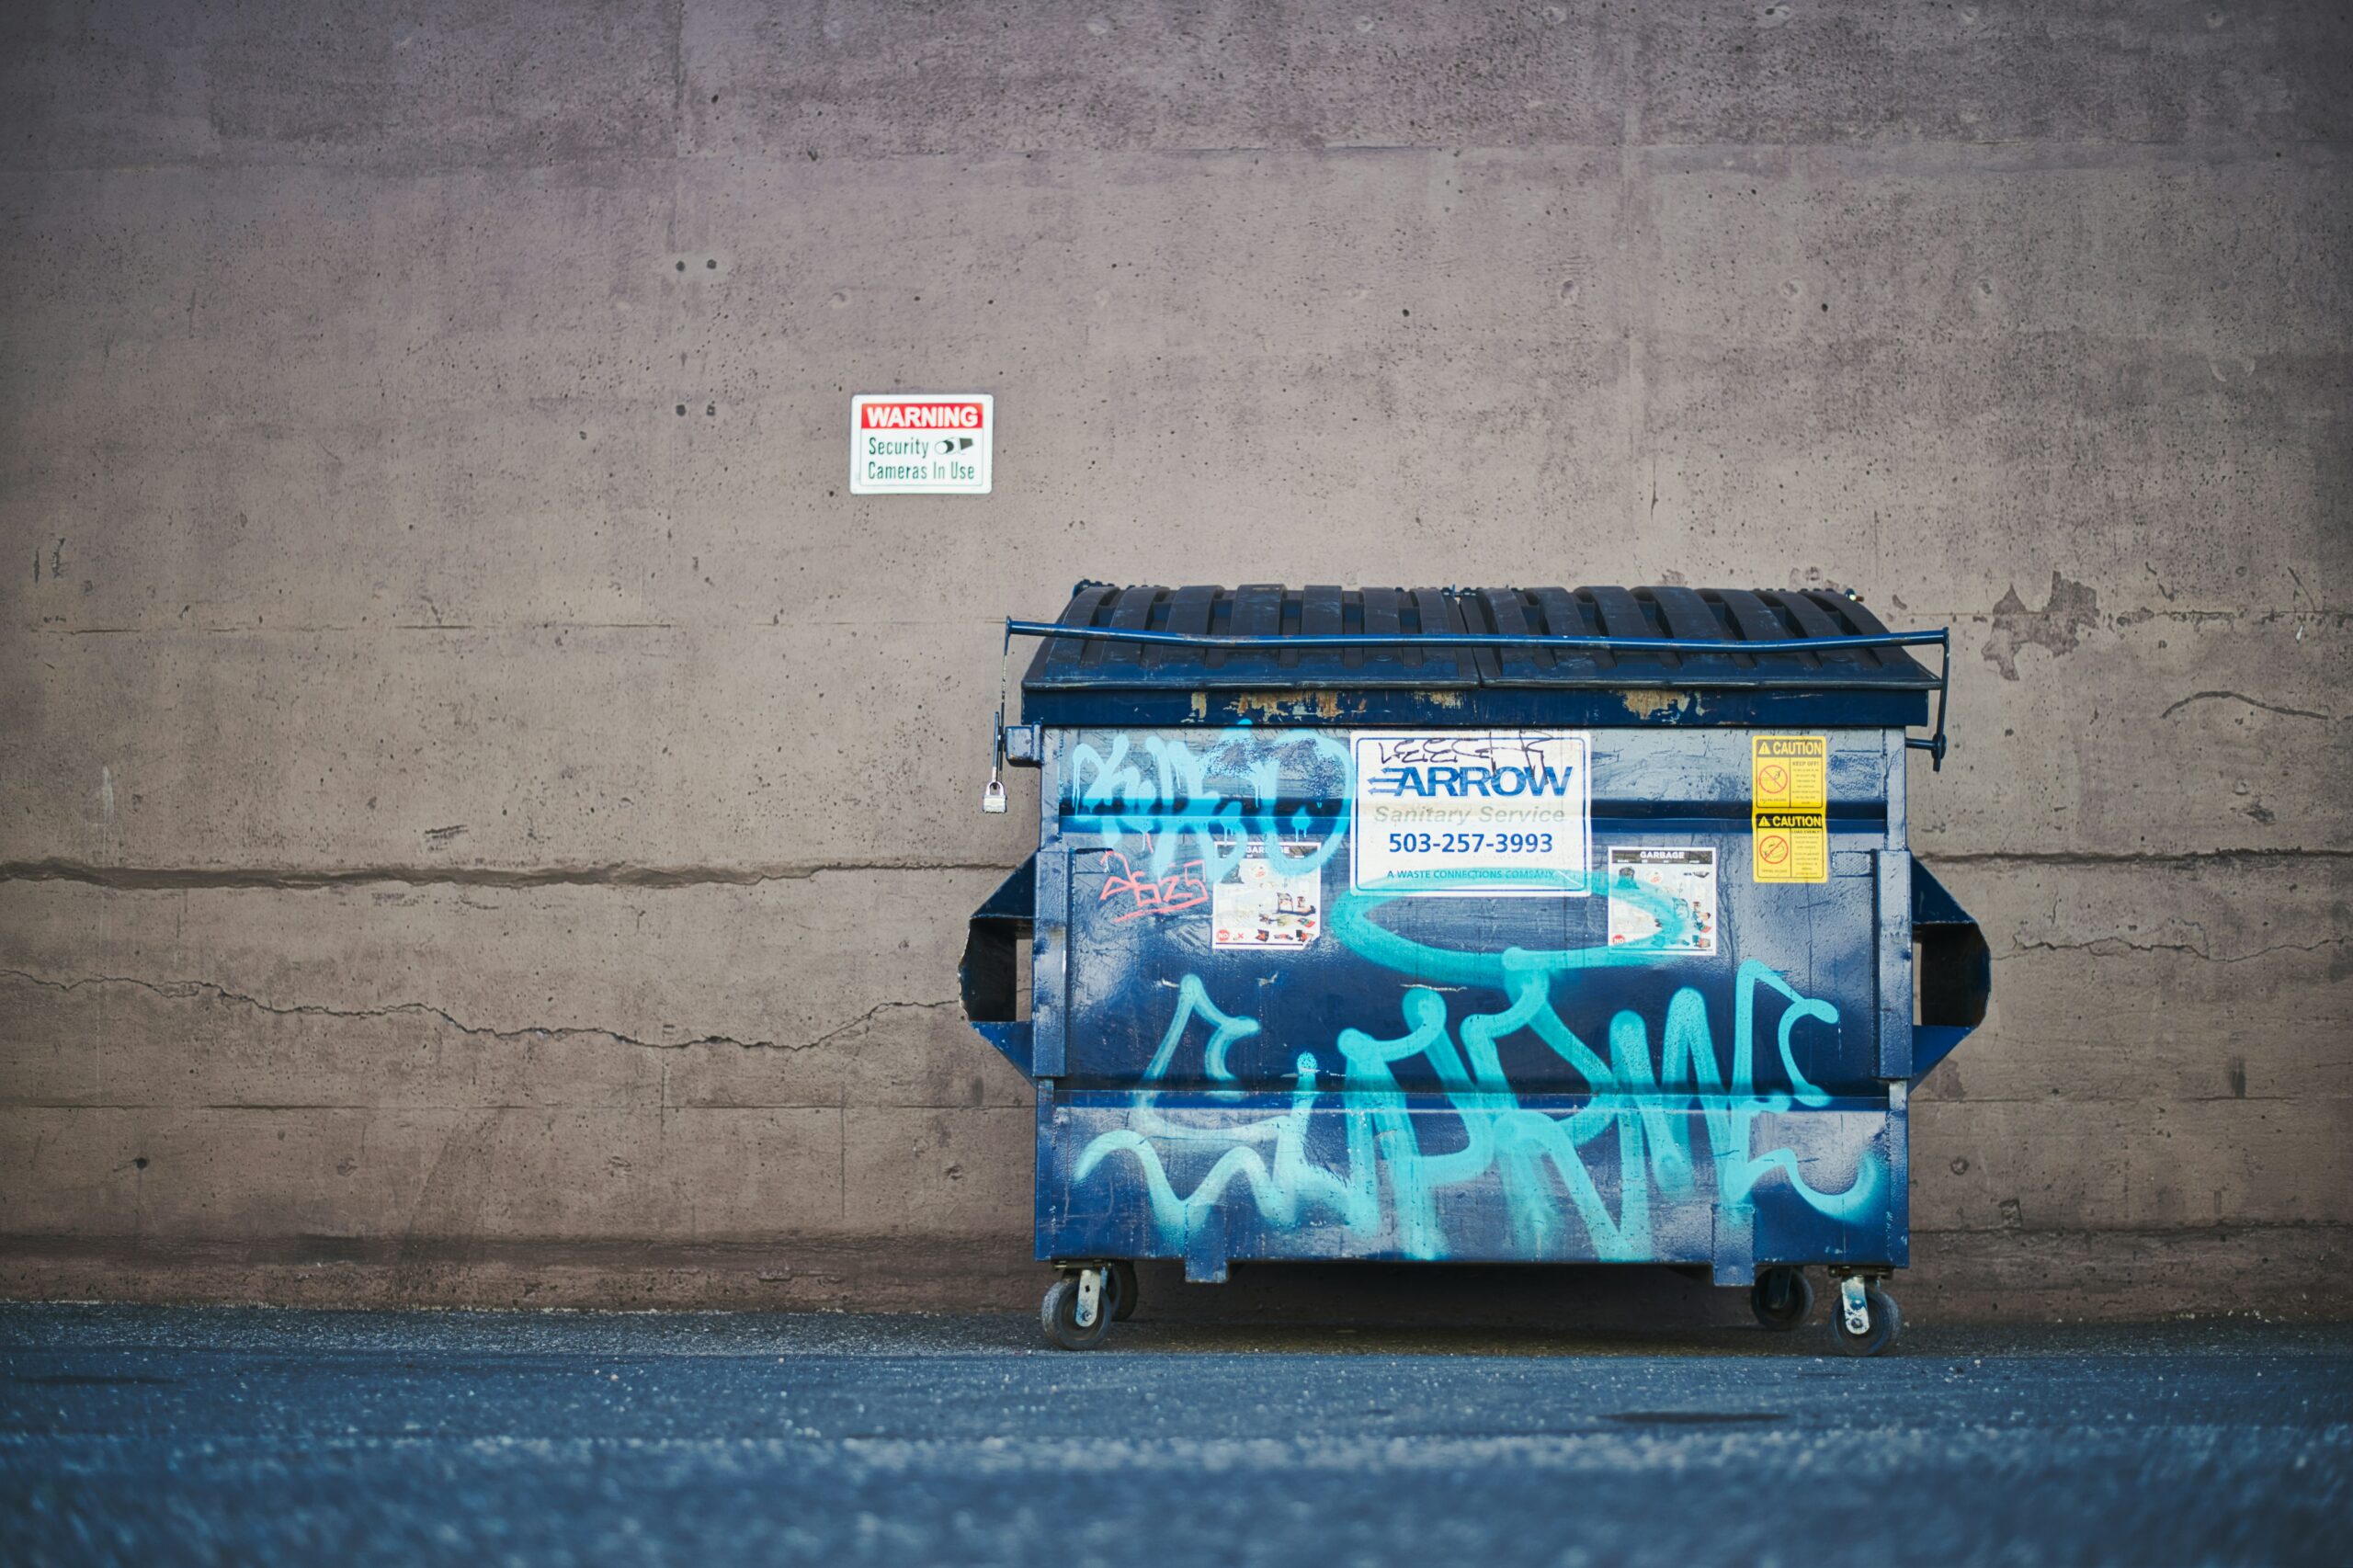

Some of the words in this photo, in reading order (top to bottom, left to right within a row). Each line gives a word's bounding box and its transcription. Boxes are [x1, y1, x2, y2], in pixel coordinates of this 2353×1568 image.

[867, 406, 978, 427] WARNING
[869, 437, 929, 459] Security
[868, 461, 927, 480] Cameras
[933, 461, 945, 479] In
[950, 461, 974, 480] Use
[1772, 742, 1822, 756] CAUTION
[1393, 767, 1573, 797] ARROW
[1374, 806, 1471, 825] Sanitary
[1478, 806, 1565, 823] Service
[1772, 815, 1822, 827] CAUTION
[1389, 833, 1553, 854] 503-257-3993
[1640, 851, 1685, 859] GARBAGE
[1387, 869, 1394, 879] A
[1396, 869, 1430, 880] WASTE
[1433, 869, 1502, 880] CONNECTIONS
